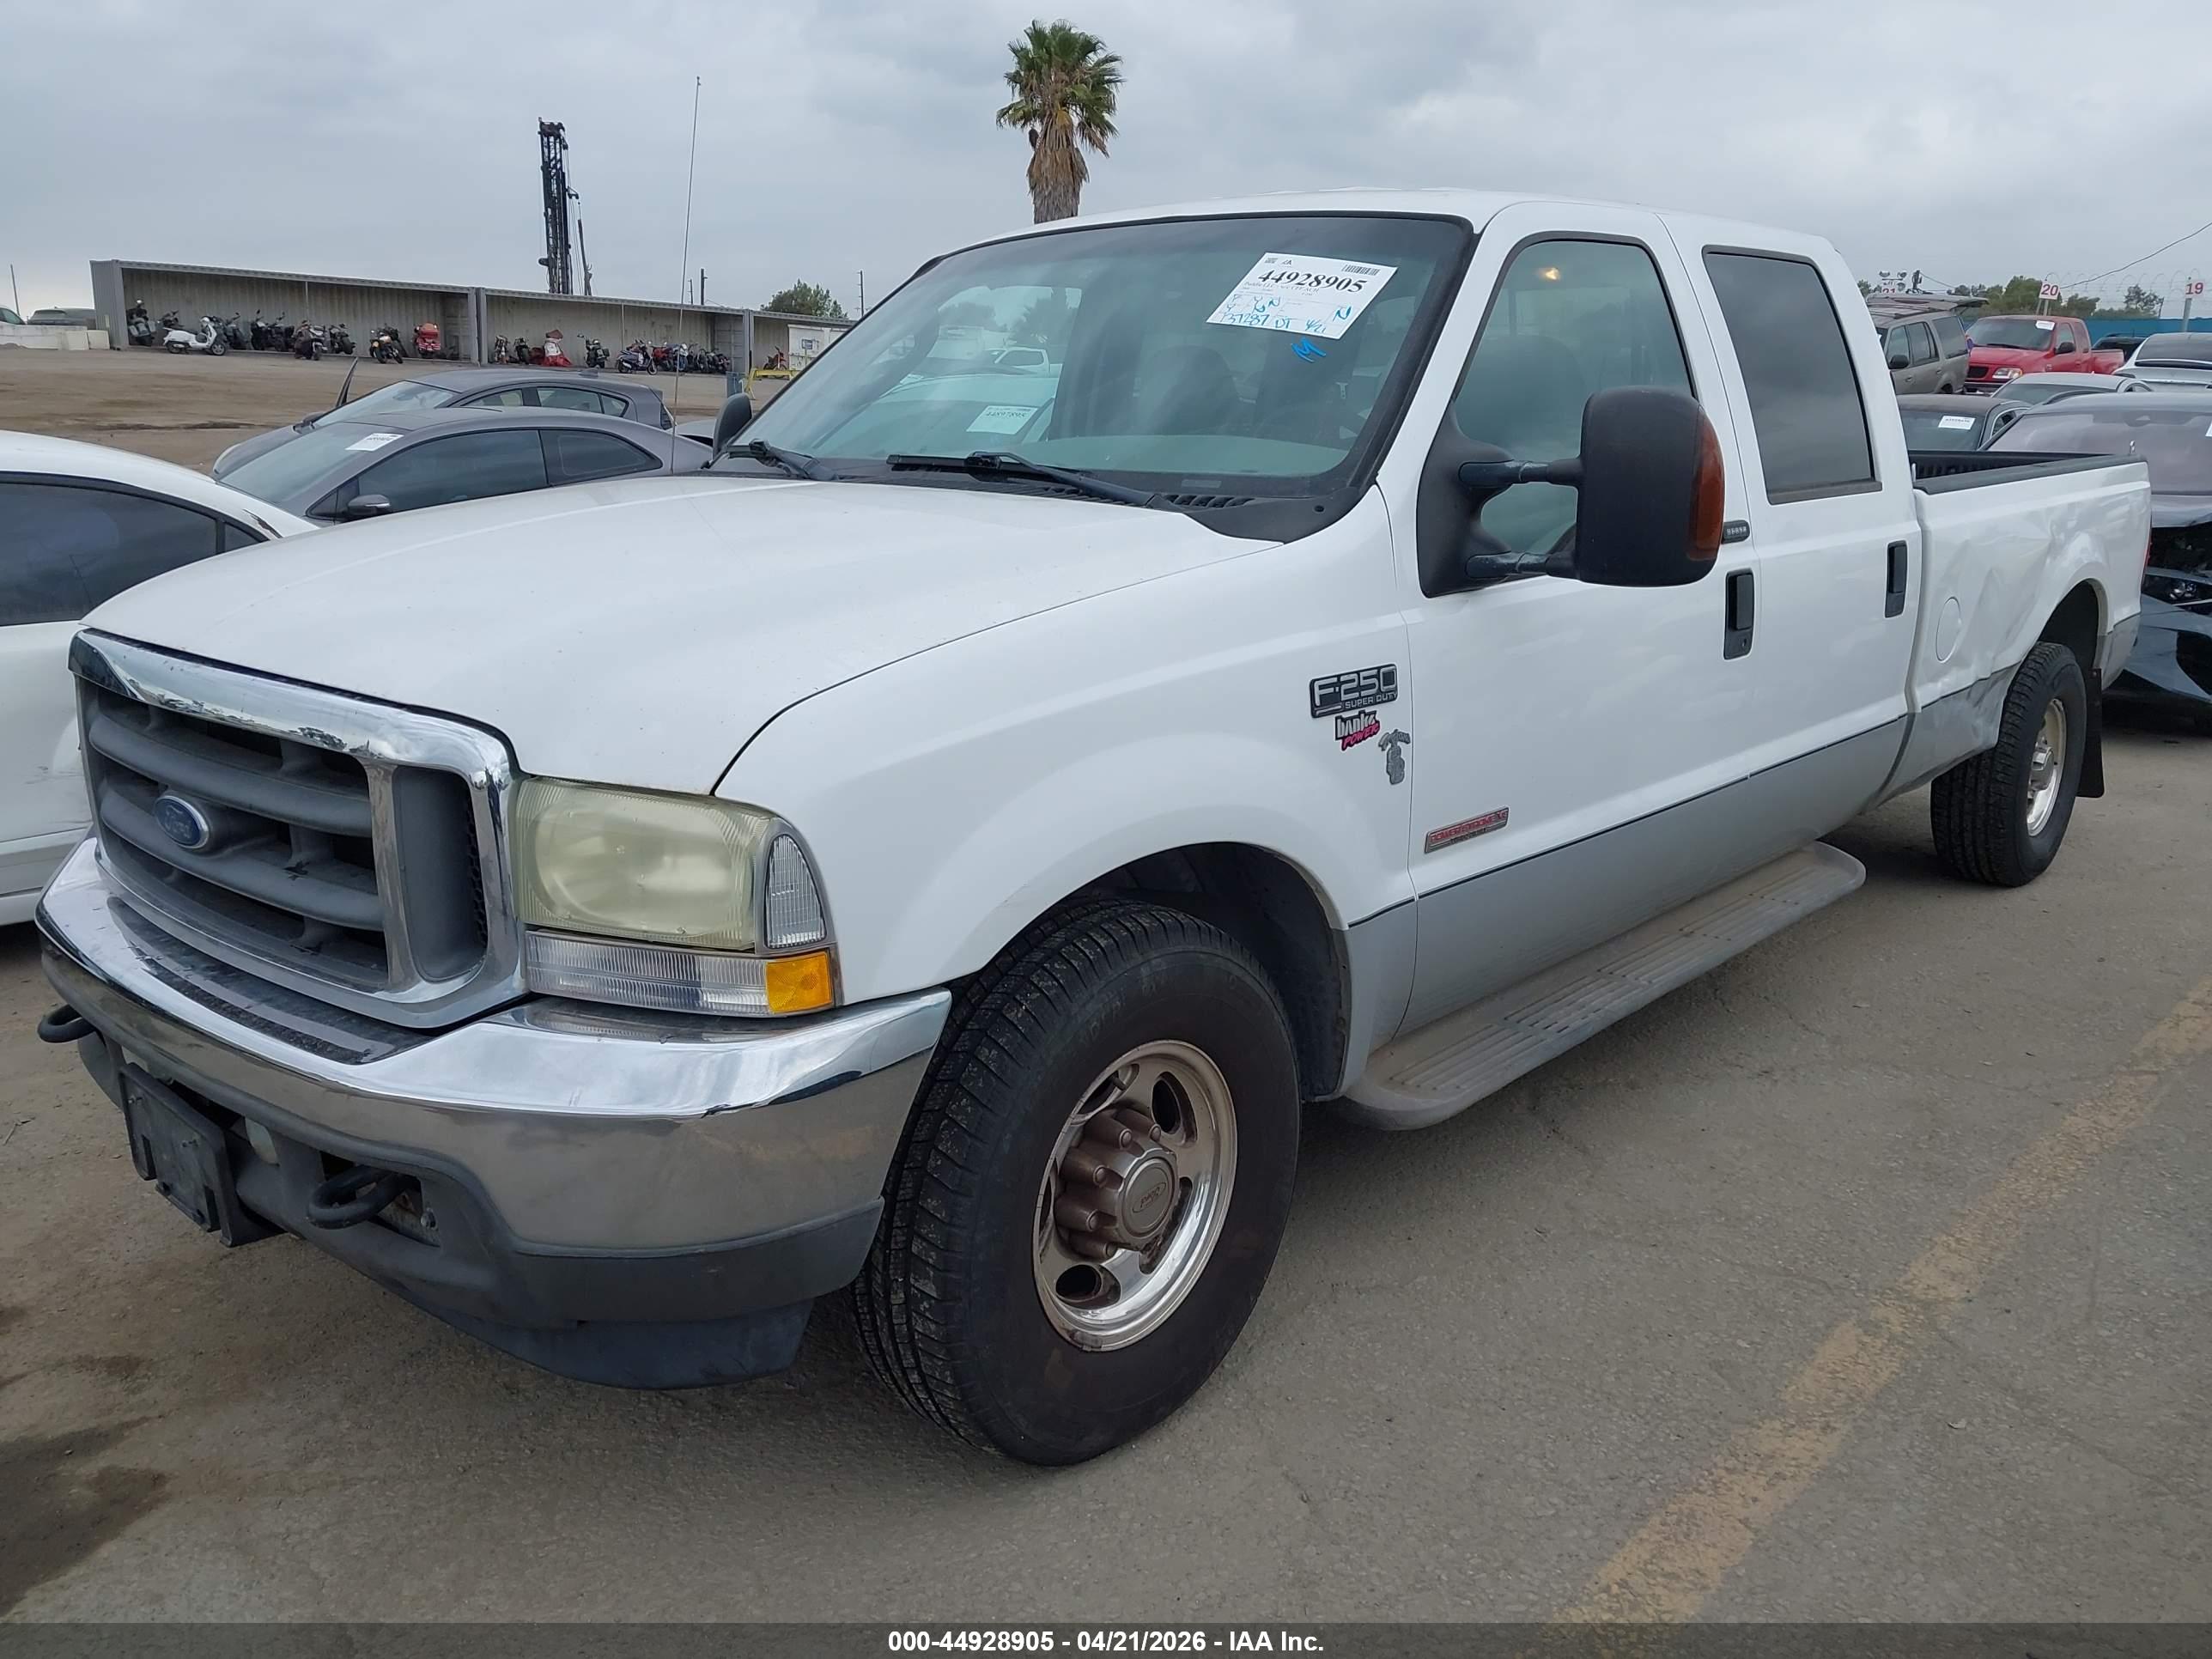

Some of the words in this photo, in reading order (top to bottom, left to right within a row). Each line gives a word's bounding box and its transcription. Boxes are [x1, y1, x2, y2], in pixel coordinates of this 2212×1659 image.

[1258, 270, 1368, 293] 44928905
[2040, 284, 2058, 296] 20
[2185, 283, 2203, 295] 19
[1314, 666, 1396, 706] F-250
[1345, 696, 1374, 708] SUPER
[1376, 692, 1398, 702] DUTY
[1343, 722, 1379, 749] POWER
